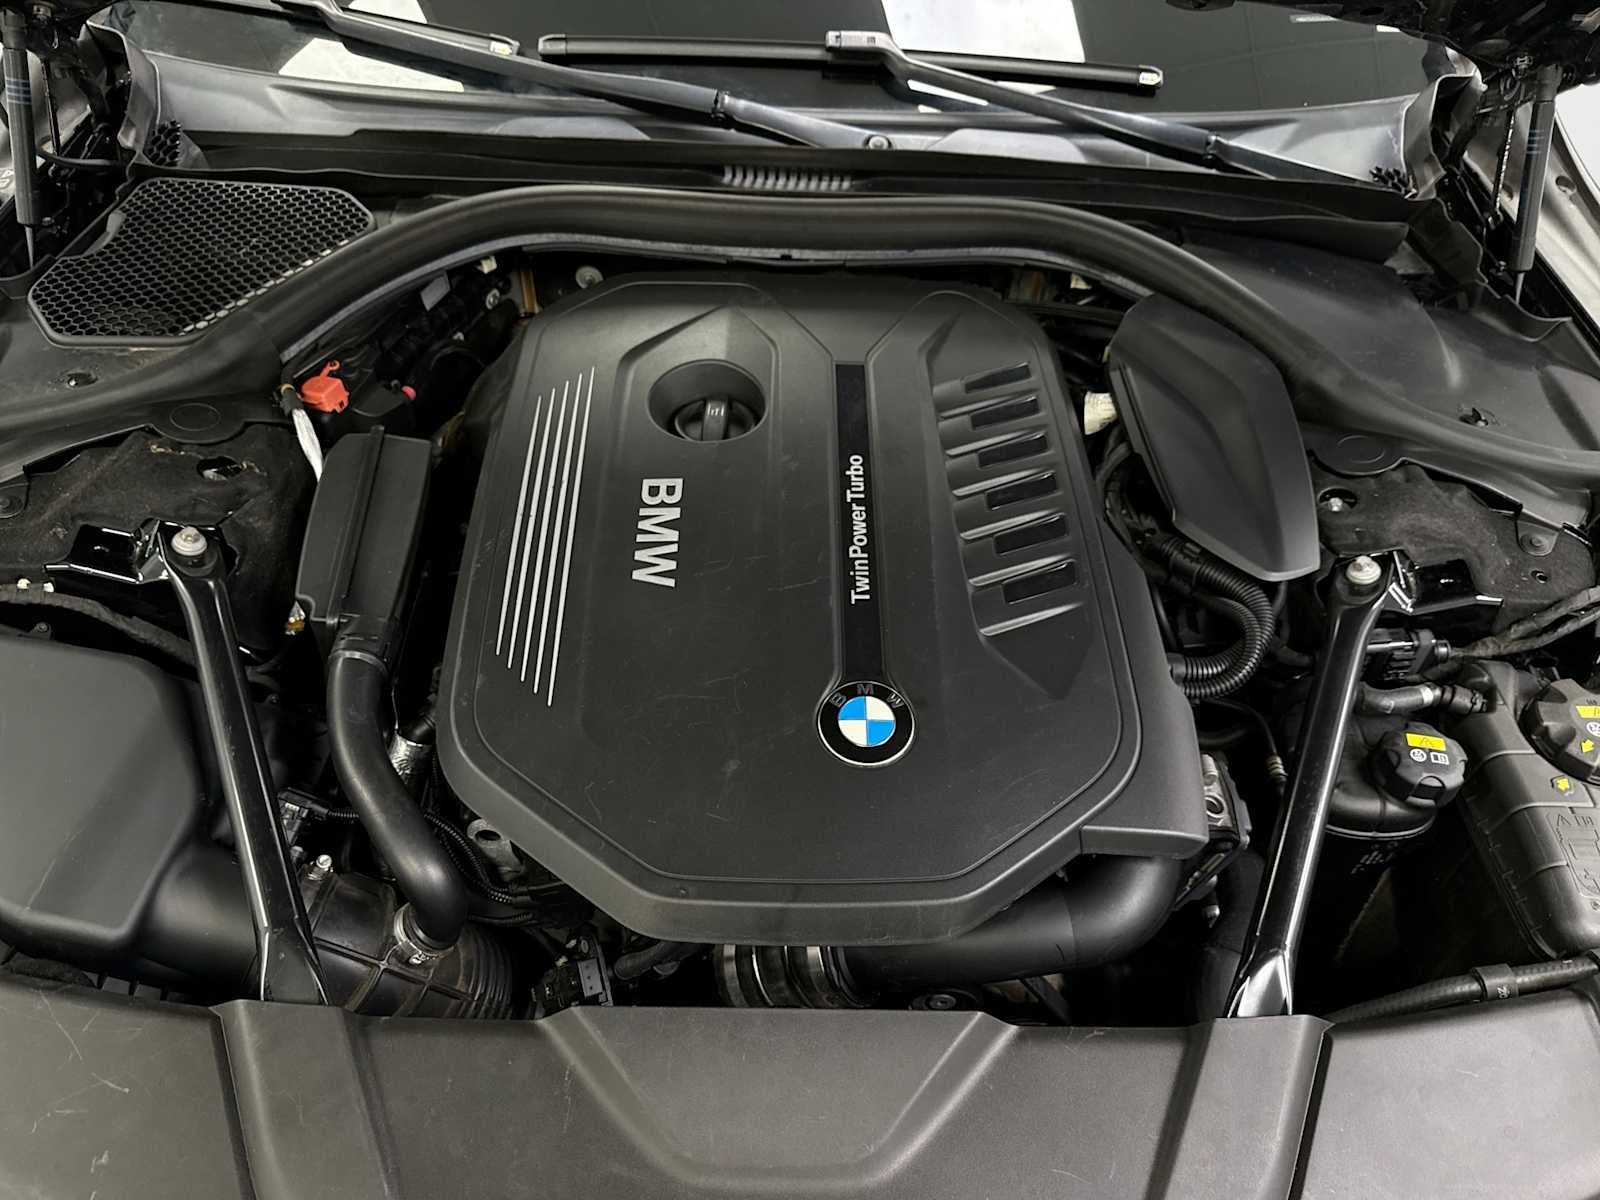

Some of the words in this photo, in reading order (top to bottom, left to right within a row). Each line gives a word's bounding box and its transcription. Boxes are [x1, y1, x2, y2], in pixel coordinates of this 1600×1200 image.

[845, 454, 865, 502] Turbo
[631, 478, 684, 588] BMW
[849, 503, 870, 605] TwinPower
[829, 683, 905, 709] BMW
